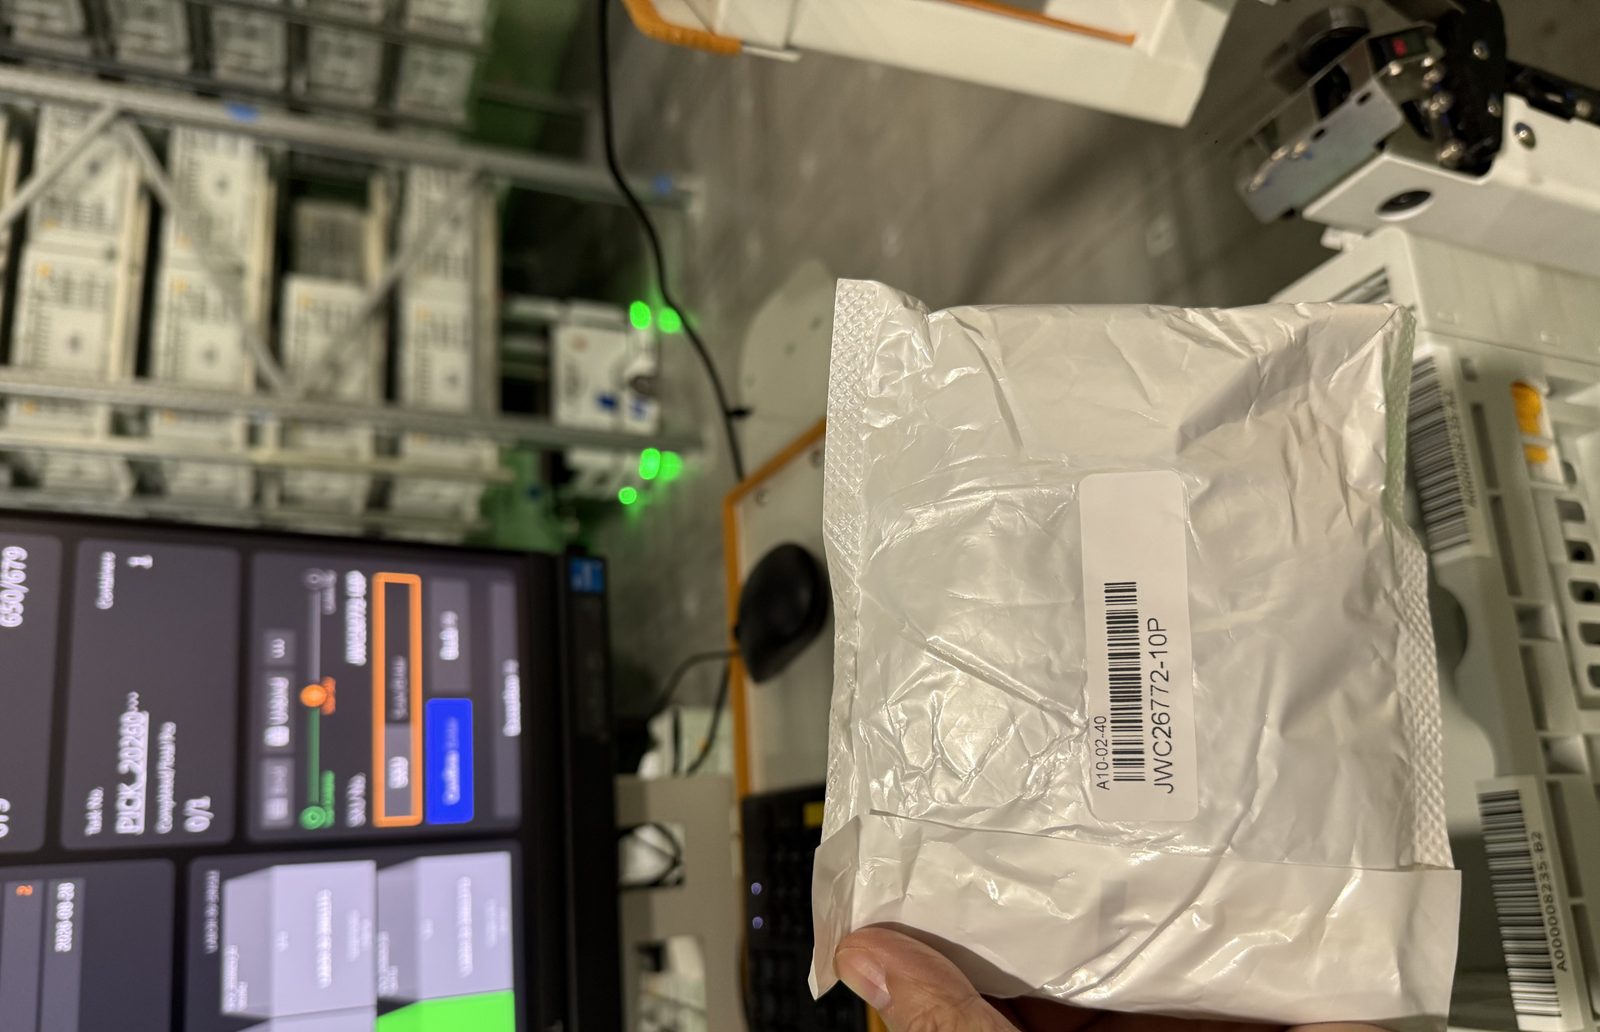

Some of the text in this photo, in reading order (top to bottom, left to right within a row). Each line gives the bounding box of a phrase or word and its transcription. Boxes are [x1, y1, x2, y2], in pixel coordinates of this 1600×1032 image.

[0, 547, 28, 628] 650/679
[1147, 617, 1174, 794] JWC26772-10P
[1094, 715, 1110, 791] A10-02-40
[184, 796, 214, 833] 0/1
[1530, 831, 1568, 973] A000008235-B2
